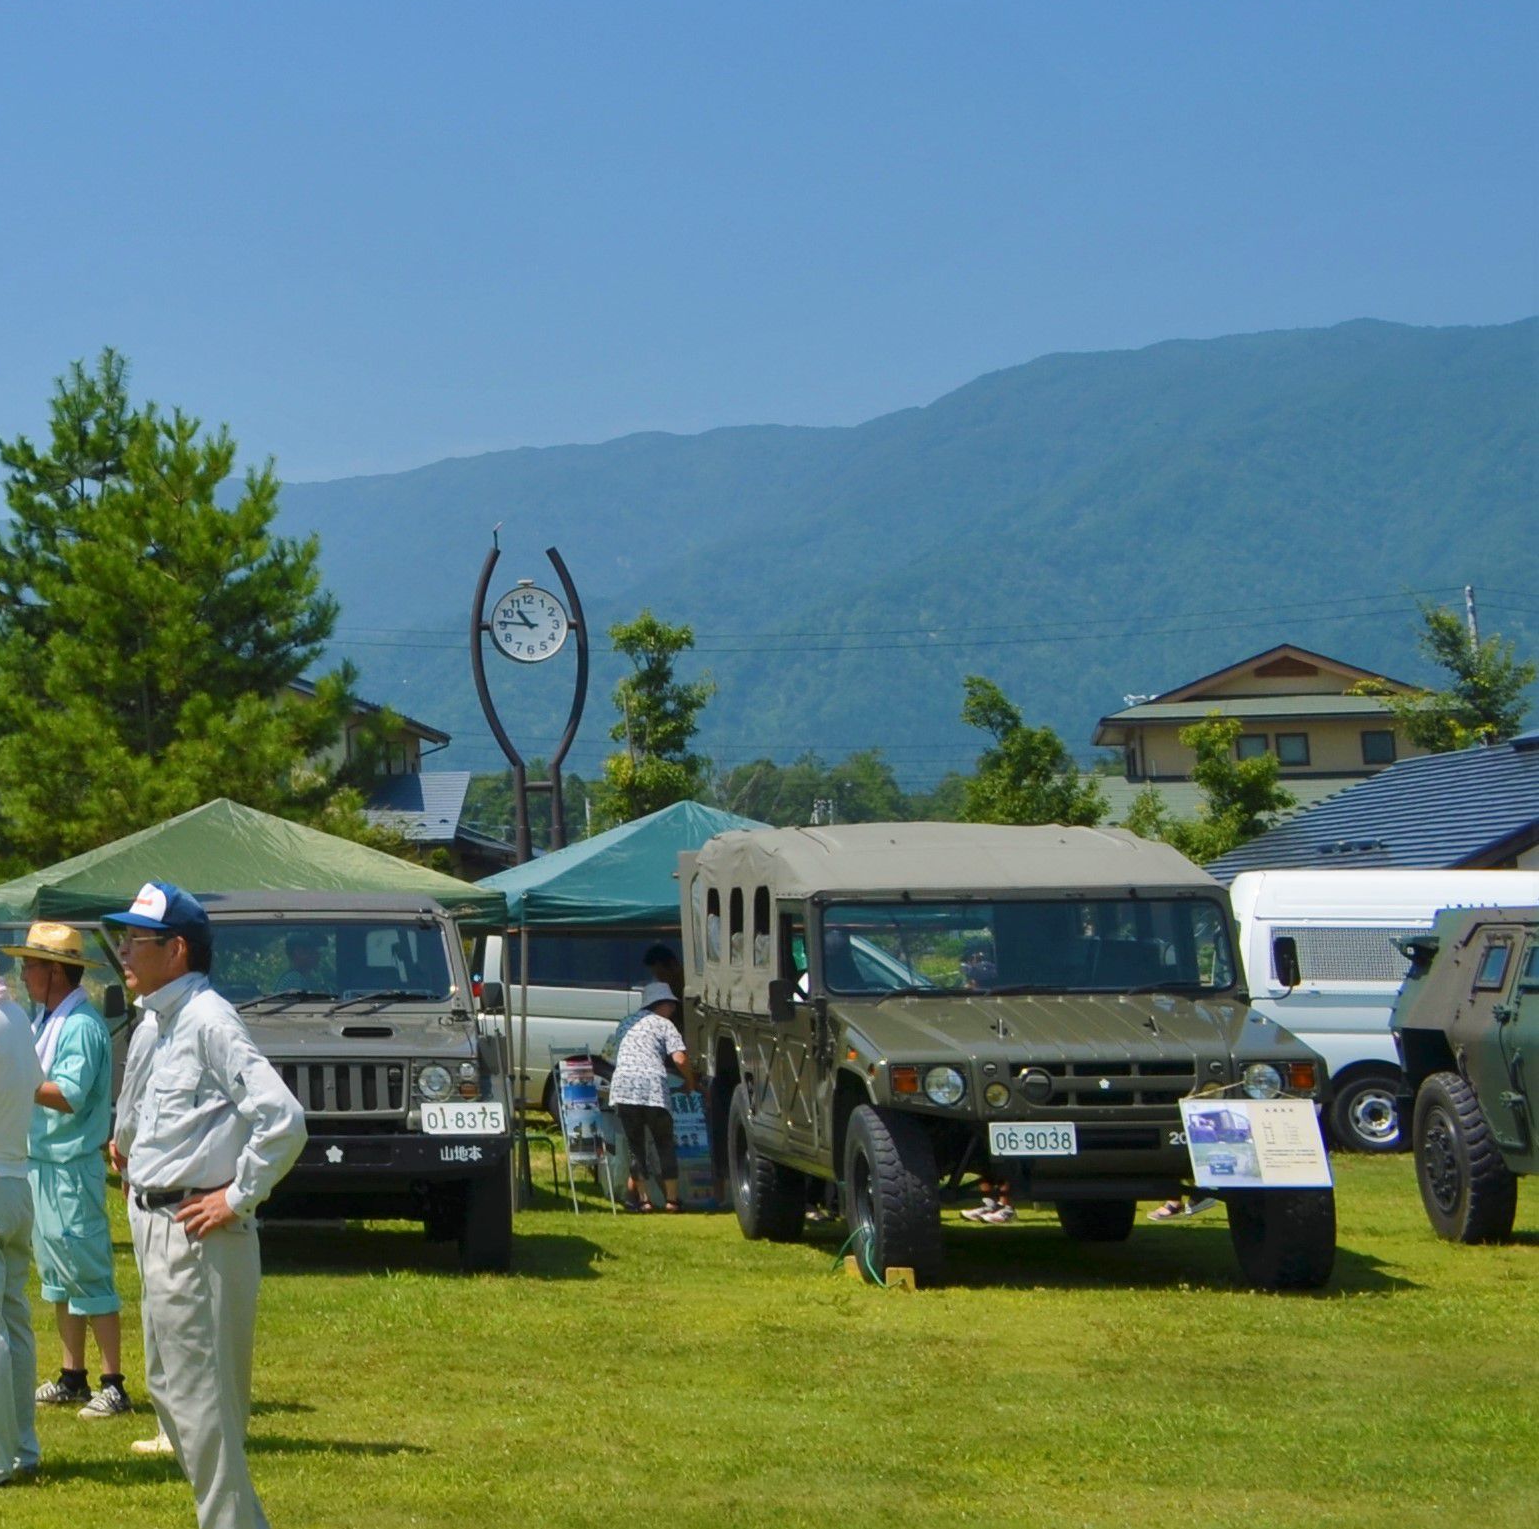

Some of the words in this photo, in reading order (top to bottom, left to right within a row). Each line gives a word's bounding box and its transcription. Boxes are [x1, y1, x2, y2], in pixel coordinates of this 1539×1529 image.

[511, 599, 520, 608] 11
[523, 595, 534, 604] 12
[540, 599, 544, 608] 1
[502, 609, 514, 618] 10
[548, 607, 555, 617] 2
[500, 621, 507, 630] 9
[552, 620, 560, 630] 3
[505, 633, 512, 643] 8
[549, 632, 555, 641] 4
[516, 643, 522, 651] 7
[528, 645, 534, 654] 6
[540, 641, 547, 650] 5
[427, 1111, 500, 1130] 01-8375
[995, 1131, 1072, 1150] 06-9038
[440, 1145, 483, 1162] 山地本
